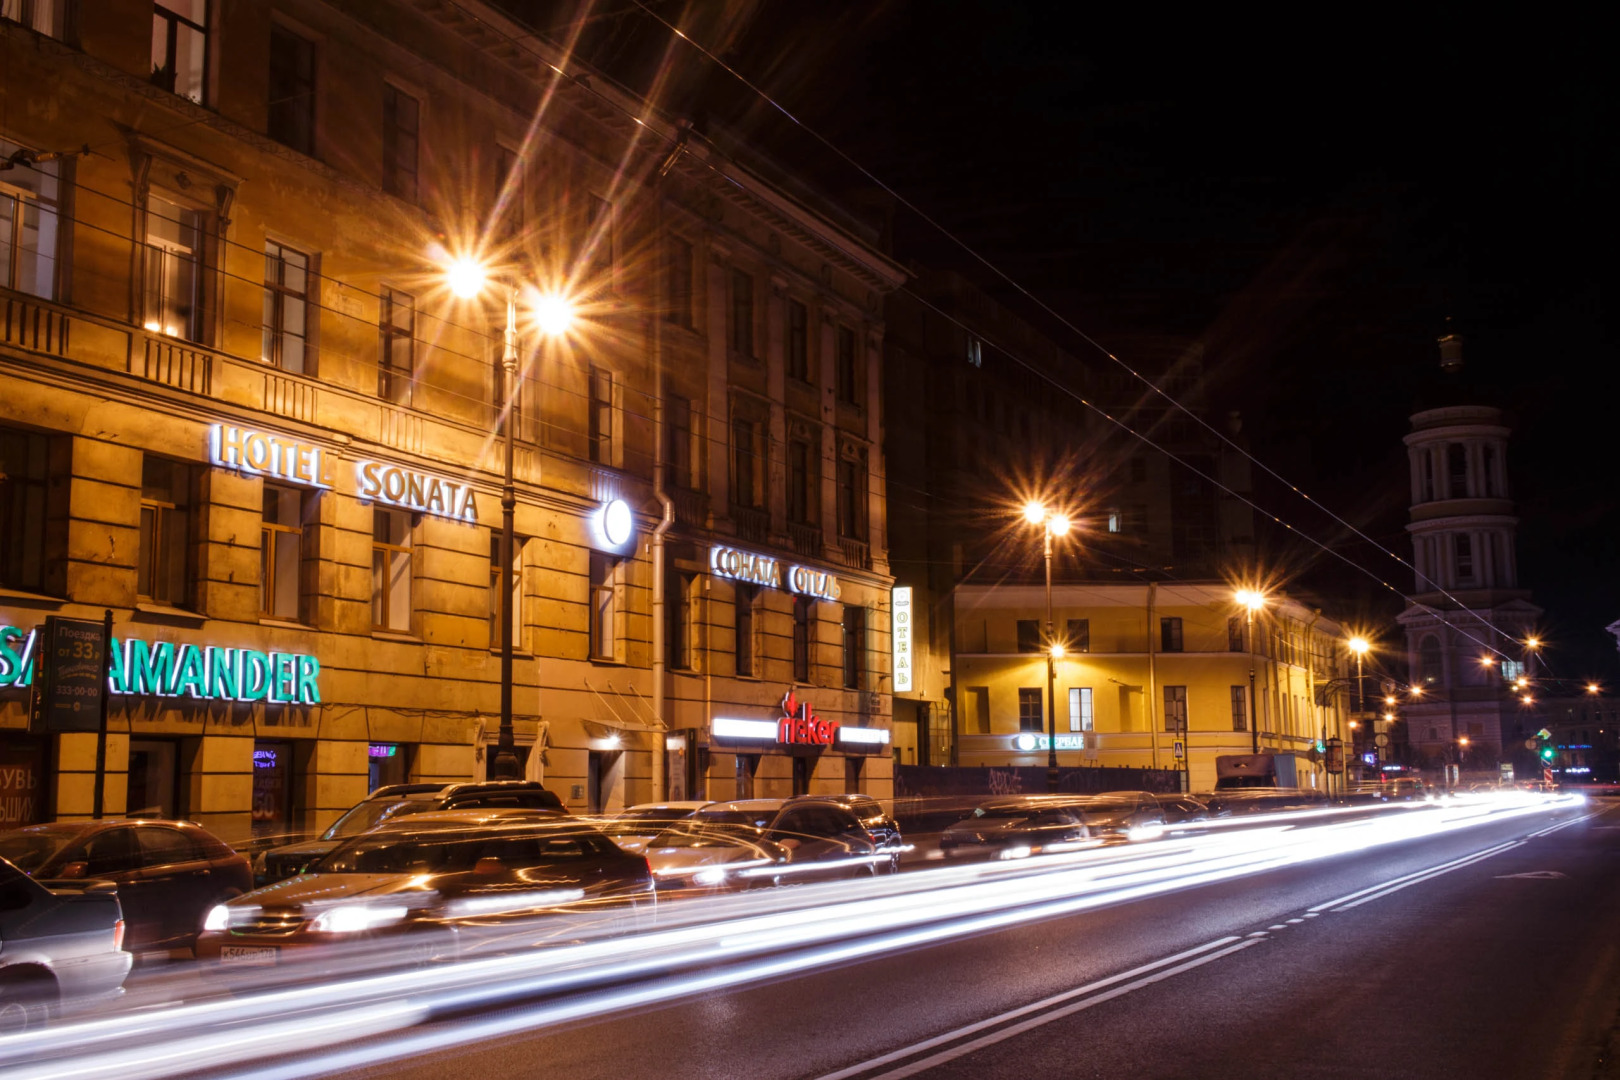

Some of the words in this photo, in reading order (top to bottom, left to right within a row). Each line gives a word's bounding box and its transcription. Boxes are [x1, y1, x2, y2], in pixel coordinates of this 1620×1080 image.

[214, 423, 335, 489] HOTEL
[361, 461, 479, 520] SONATA
[715, 547, 781, 586] СОНАТА
[794, 567, 842, 599] ОТЕЛЬ
[60, 627, 101, 641] Поездка
[73, 641, 93, 659] 33
[896, 610, 908, 685] ОТЕЛЬ
[0, 625, 321, 705] SAMANDER
[777, 700, 839, 745] rieker
[0, 768, 37, 790] УВЬ
